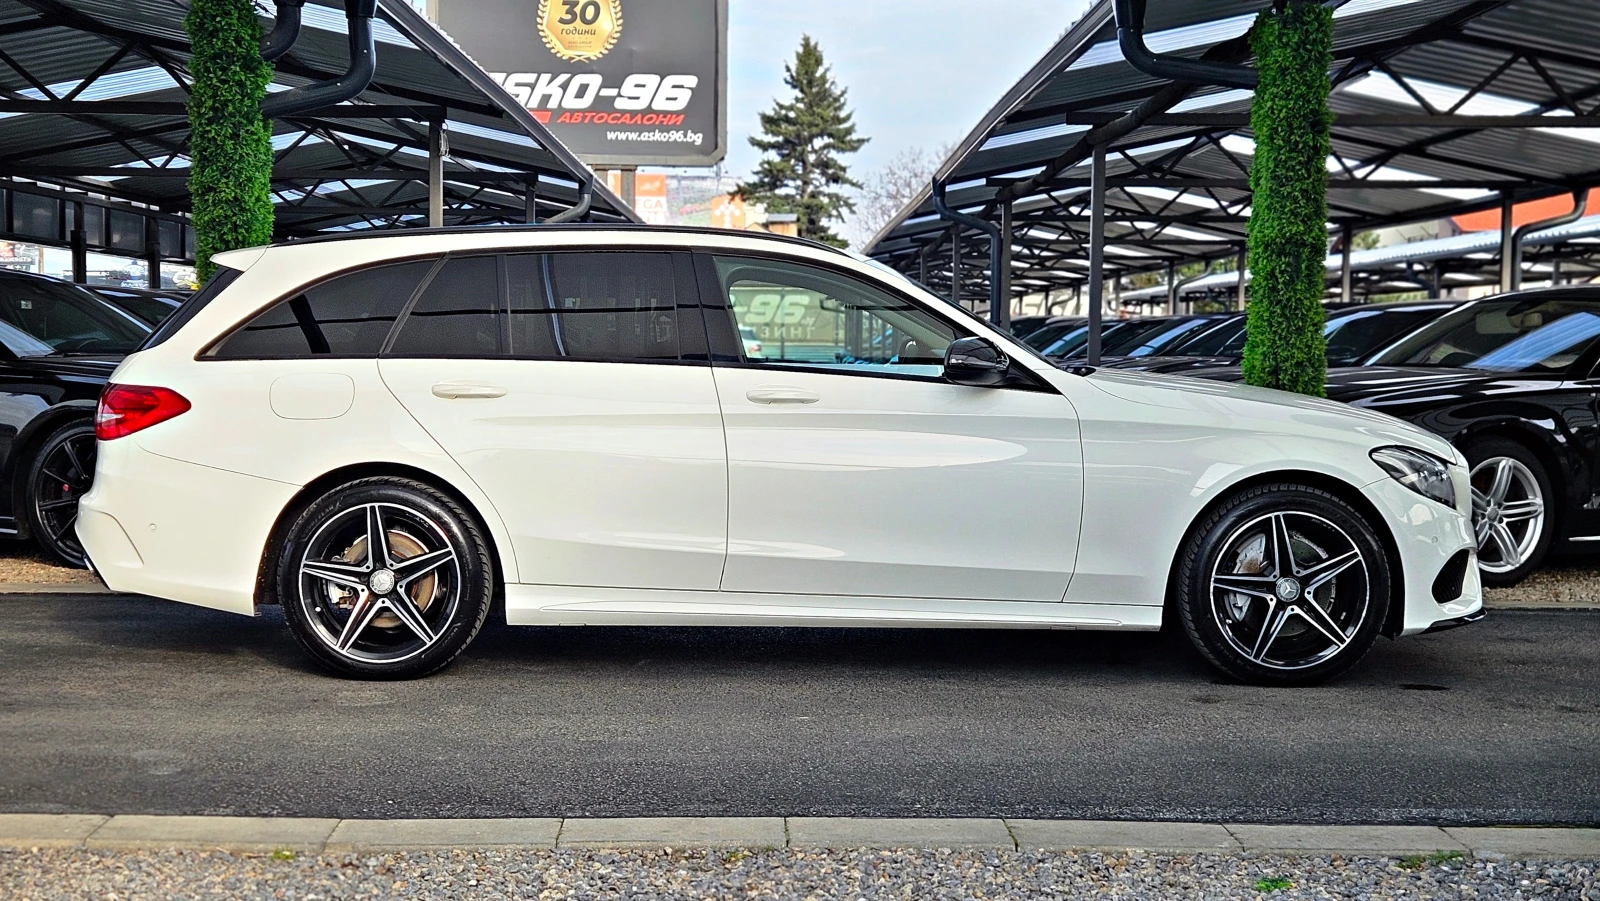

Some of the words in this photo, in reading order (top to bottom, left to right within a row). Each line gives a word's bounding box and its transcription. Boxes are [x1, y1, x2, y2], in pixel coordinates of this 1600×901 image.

[557, 0, 601, 25] 30
[560, 26, 597, 36] години
[556, 111, 685, 126] АВТОСАЛОНИ
[606, 129, 703, 145] www.asko96.bg
[731, 294, 810, 324] -96
